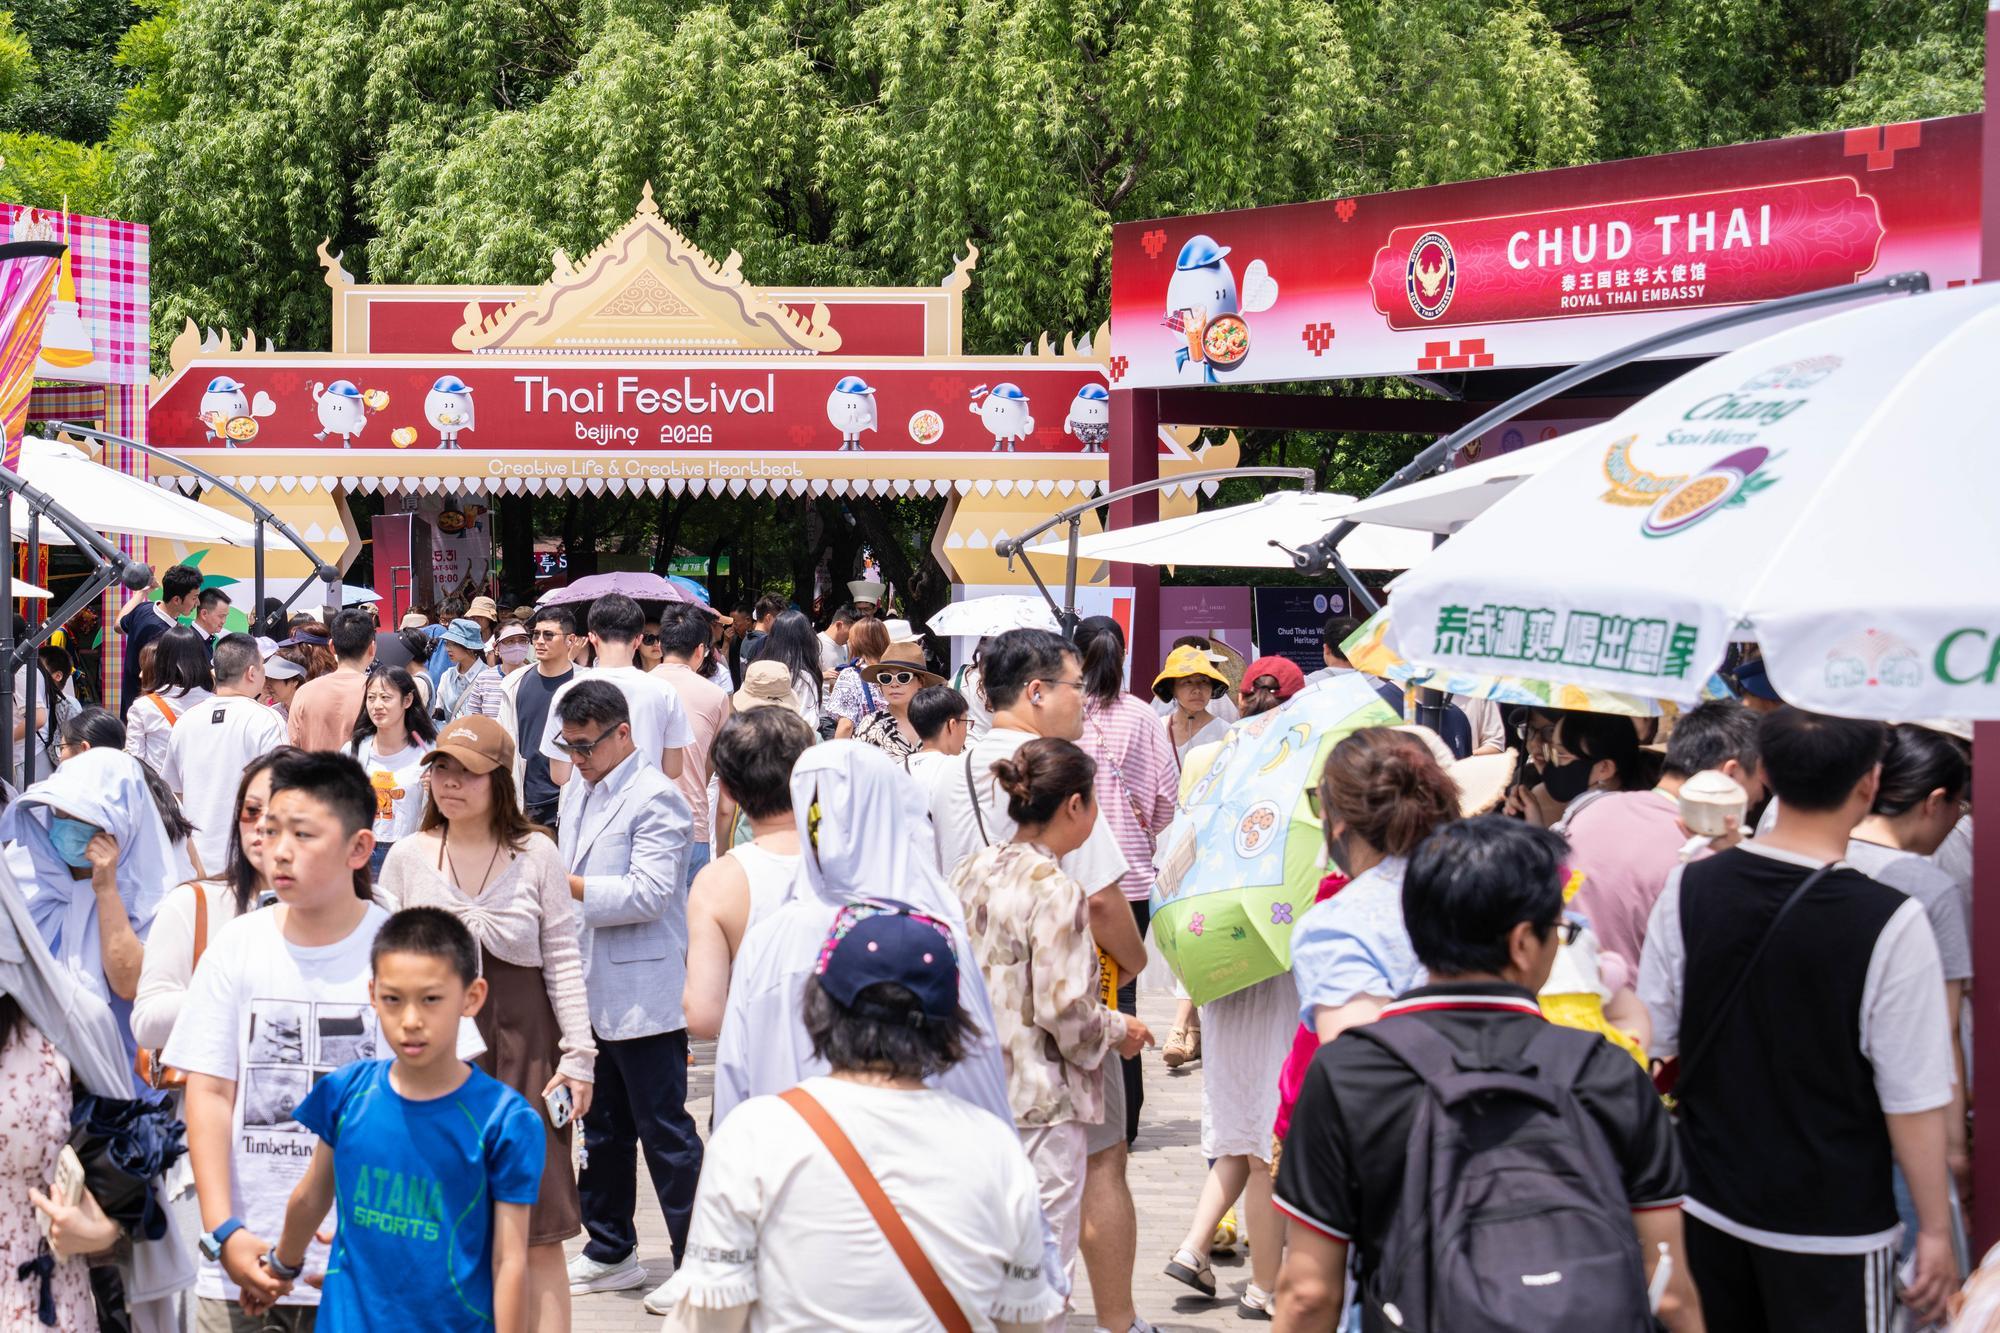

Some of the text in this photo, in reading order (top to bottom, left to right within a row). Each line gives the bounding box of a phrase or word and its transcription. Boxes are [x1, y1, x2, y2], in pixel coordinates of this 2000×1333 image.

[1507, 204, 1771, 270] CHUD THAI
[1561, 262, 1706, 292] 泰王国驻华大使馆
[1561, 284, 1705, 308] ROYAL THAI EMBASSY
[514, 373, 774, 414] Thai Festival
[1682, 393, 1810, 427] Chang
[575, 421, 712, 446] Beijing 2026
[488, 459, 803, 477] Creative Life & Creative Heartbeat
[433, 550, 457, 562] 5.31
[1277, 627, 1294, 635] Chud
[1295, 627, 1308, 635] Thai
[1293, 637, 1319, 646] Heritage
[242, 1135, 313, 1157] Timberlan
[354, 1164, 444, 1220] ATANA
[354, 1206, 440, 1241] SPORTS
